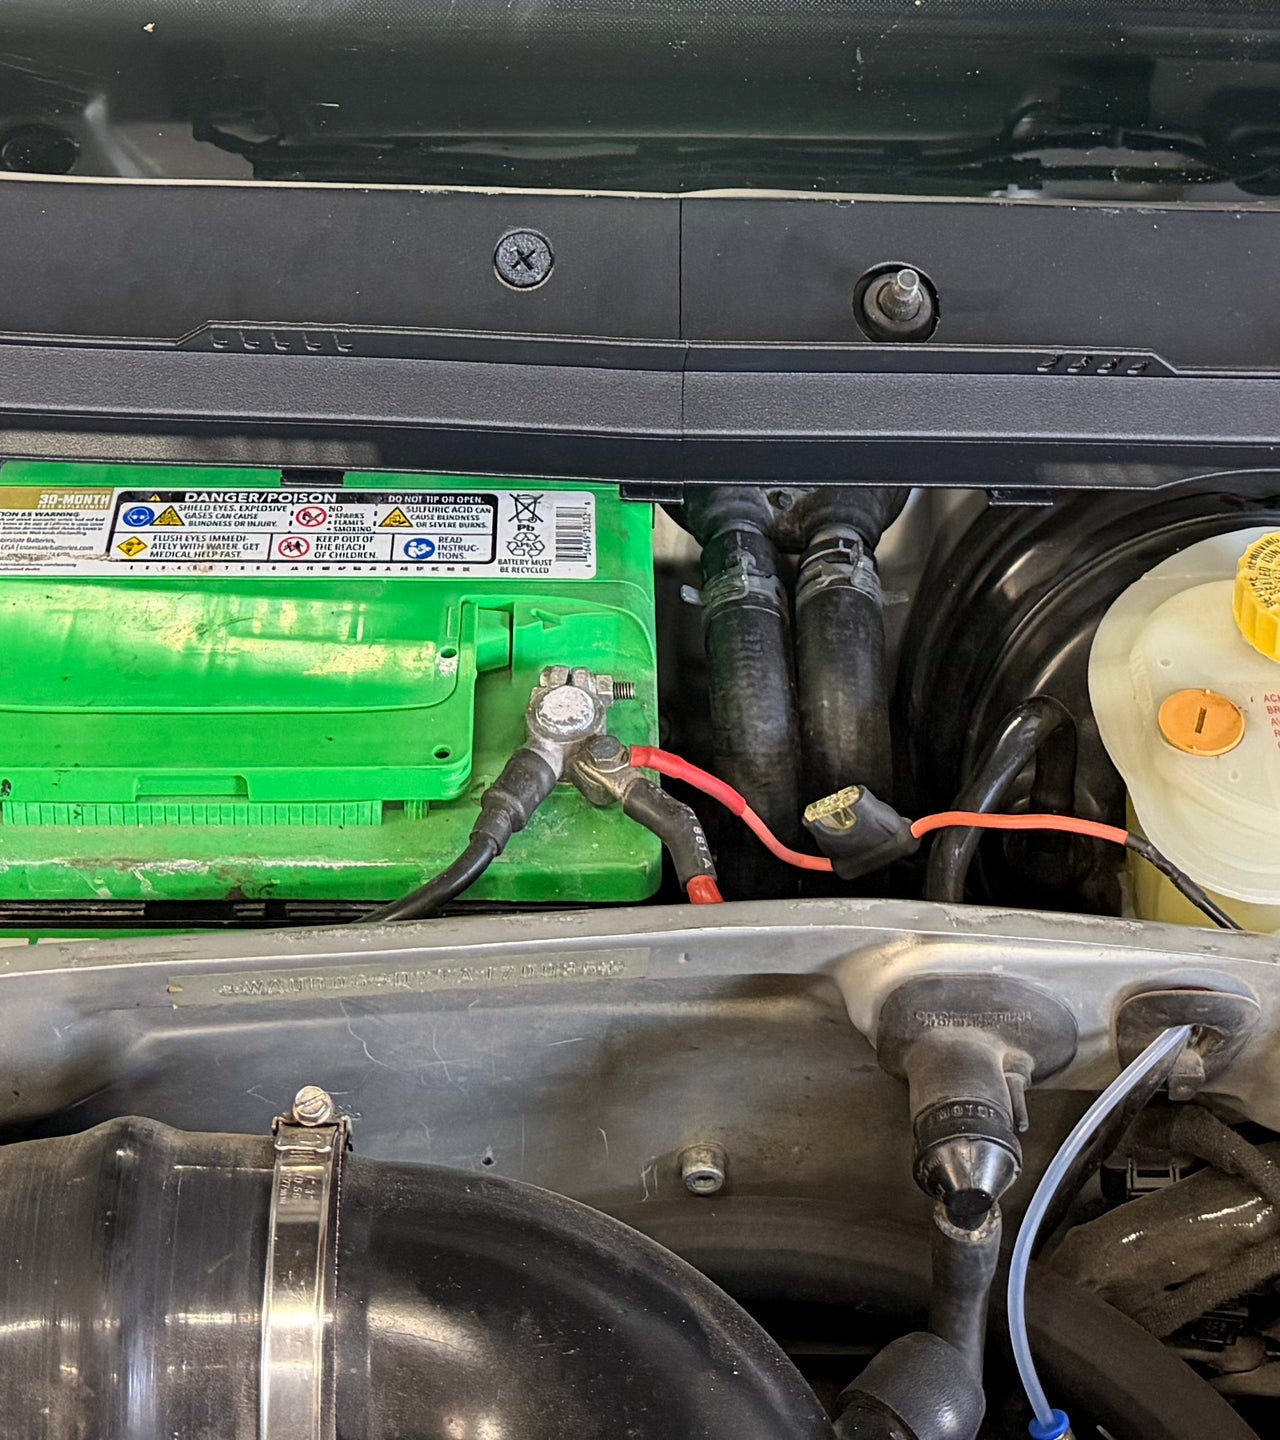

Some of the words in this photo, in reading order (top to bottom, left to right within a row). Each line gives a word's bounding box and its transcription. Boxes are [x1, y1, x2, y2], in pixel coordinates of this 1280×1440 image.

[39, 493, 111, 505] 30-MONTH
[184, 492, 337, 503] DANGER/POISON
[388, 495, 403, 503] DO
[404, 495, 422, 503] NOT
[424, 495, 440, 503] TIP
[441, 495, 455, 504] OR
[456, 496, 485, 504] OPEN.
[247, 520, 278, 528] INJURY.
[415, 521, 428, 529] OR
[428, 521, 457, 529] SEVERE
[458, 521, 488, 529] BURNS.
[517, 524, 535, 532] Pb
[152, 534, 183, 543] FLUSH
[184, 535, 207, 543] EYES
[209, 535, 249, 543] IMMEDI-
[438, 536, 463, 544] READ
[150, 542, 178, 551] ATELY
[179, 542, 206, 551] WITH
[207, 543, 239, 551] WATER.
[242, 543, 260, 551] GET
[334, 543, 366, 551] REACH
[437, 544, 480, 552] INSTRUC-
[149, 550, 193, 559] MEDICAL
[194, 550, 218, 559] HELP
[219, 550, 243, 559] FAST.
[314, 551, 327, 559] OF
[328, 551, 378, 559] CHILDREN.
[437, 552, 467, 560] TIONS.
